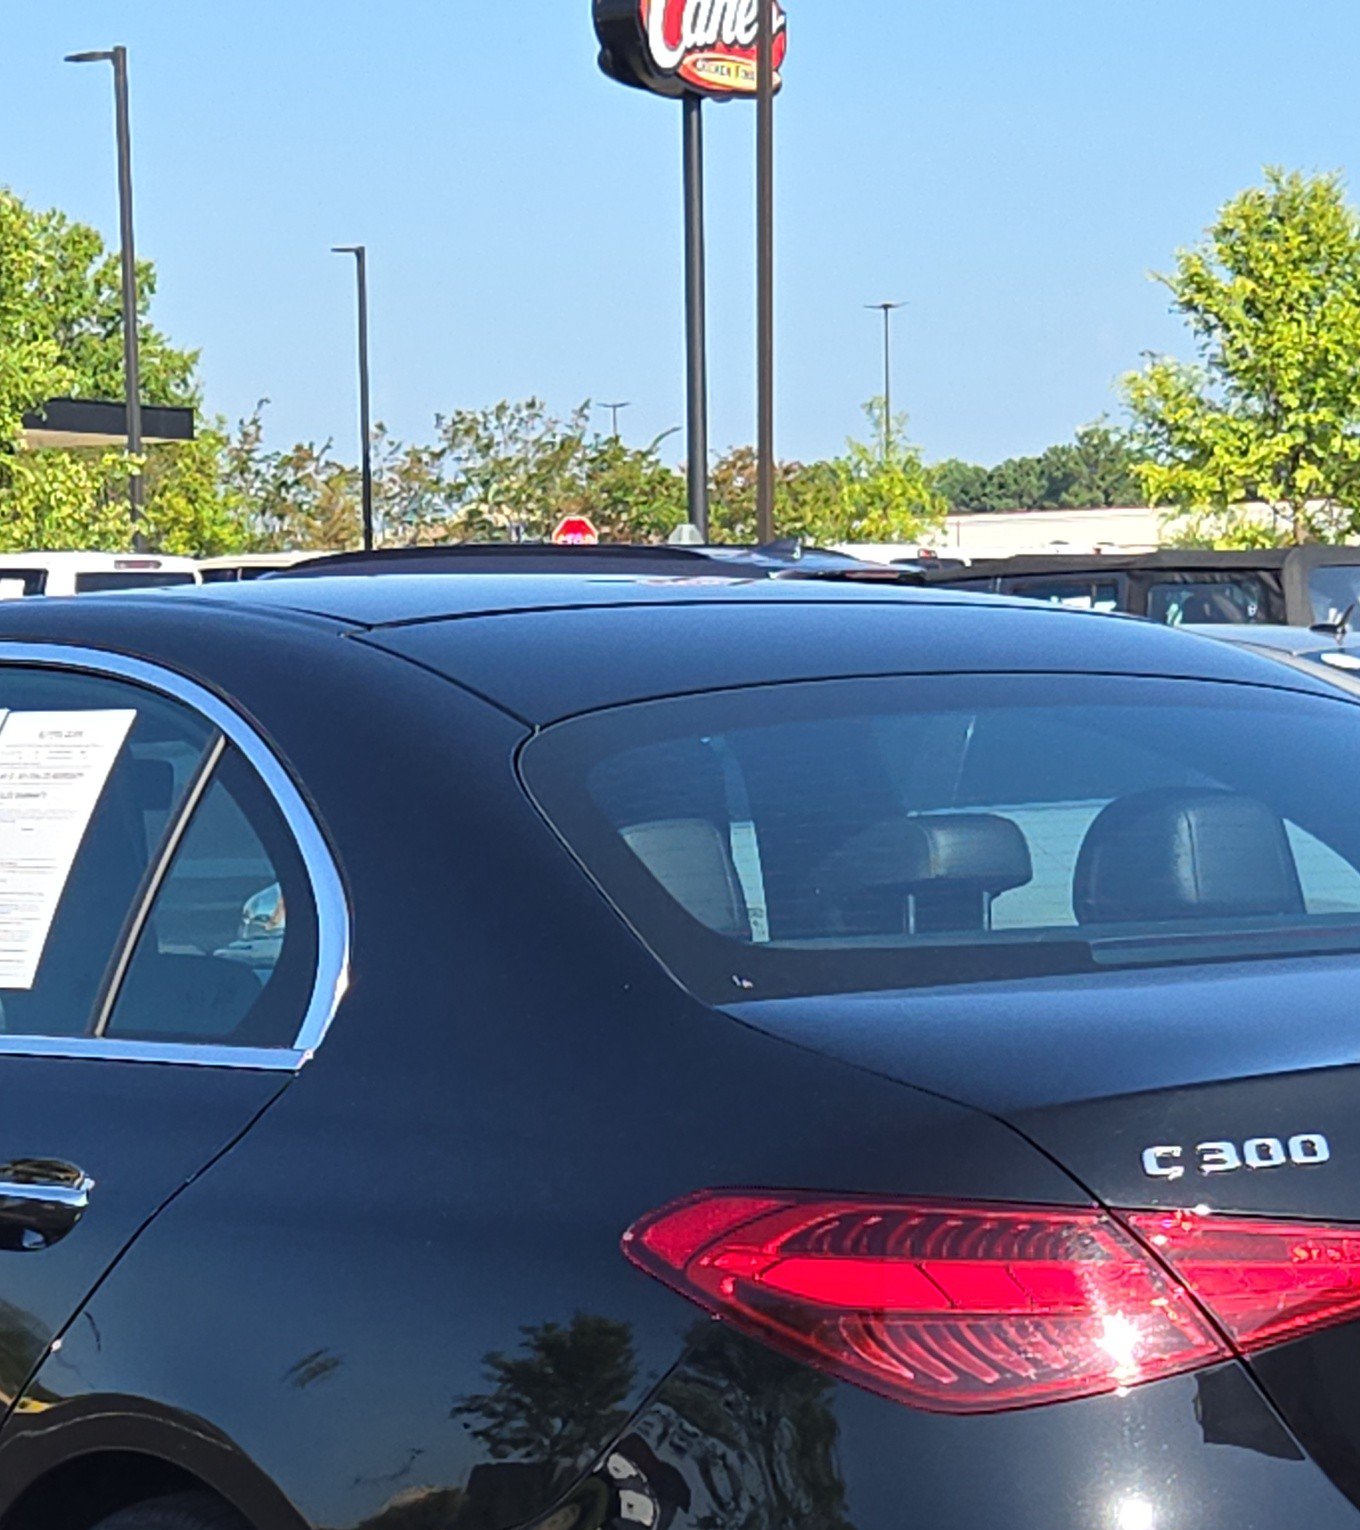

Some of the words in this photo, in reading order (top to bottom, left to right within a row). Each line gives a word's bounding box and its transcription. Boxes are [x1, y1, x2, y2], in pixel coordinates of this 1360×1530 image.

[648, 0, 786, 69] Cane
[1141, 1145, 1185, 1180] C
[1195, 1133, 1331, 1175] 300
